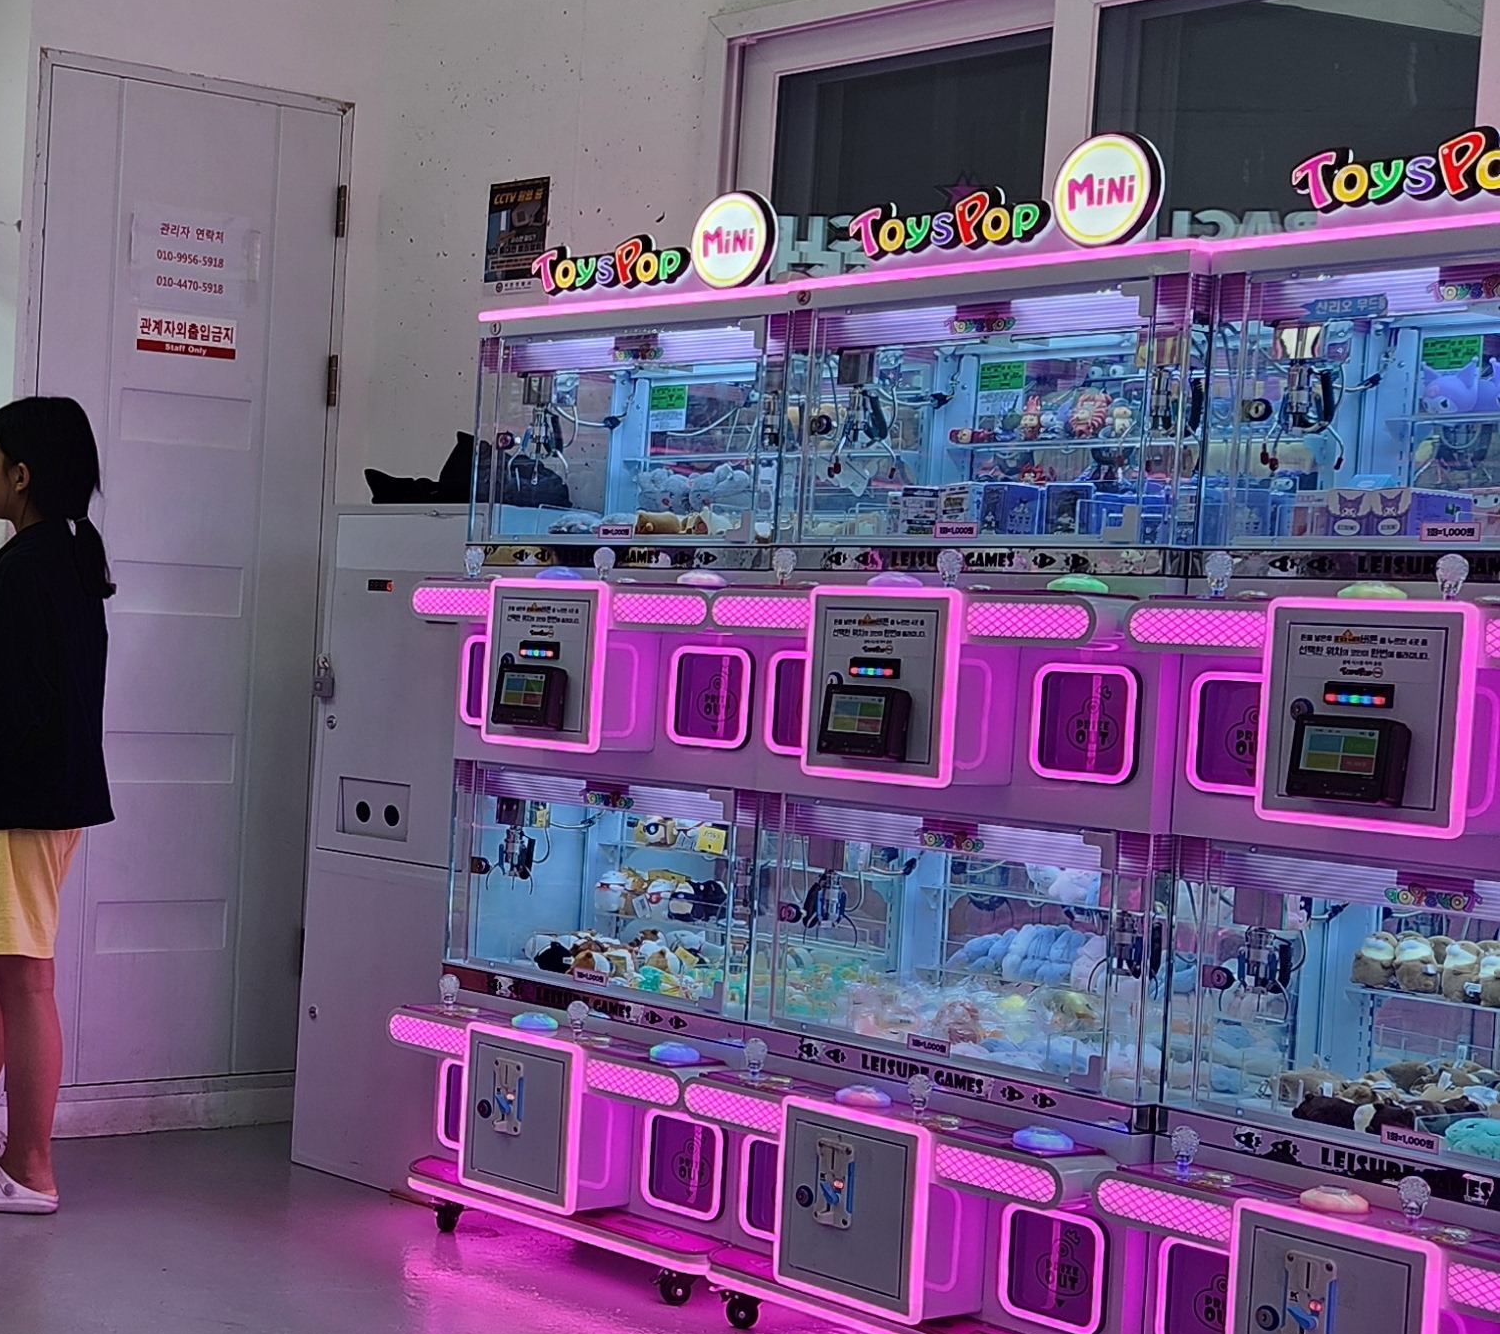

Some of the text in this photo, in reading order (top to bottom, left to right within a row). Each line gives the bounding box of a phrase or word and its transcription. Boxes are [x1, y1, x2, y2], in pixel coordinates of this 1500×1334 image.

[159, 222, 225, 244] 관리자 연락처
[156, 248, 225, 269] 010-9956-5918
[156, 275, 225, 295] 010-4470-5918
[1314, 298, 1353, 315] 산리오
[138, 316, 235, 345] 관계자외출입금지
[164, 342, 208, 357] Staff Only
[890, 550, 1015, 568] LEISU GAMES
[933, 1069, 985, 1095] GAMES
